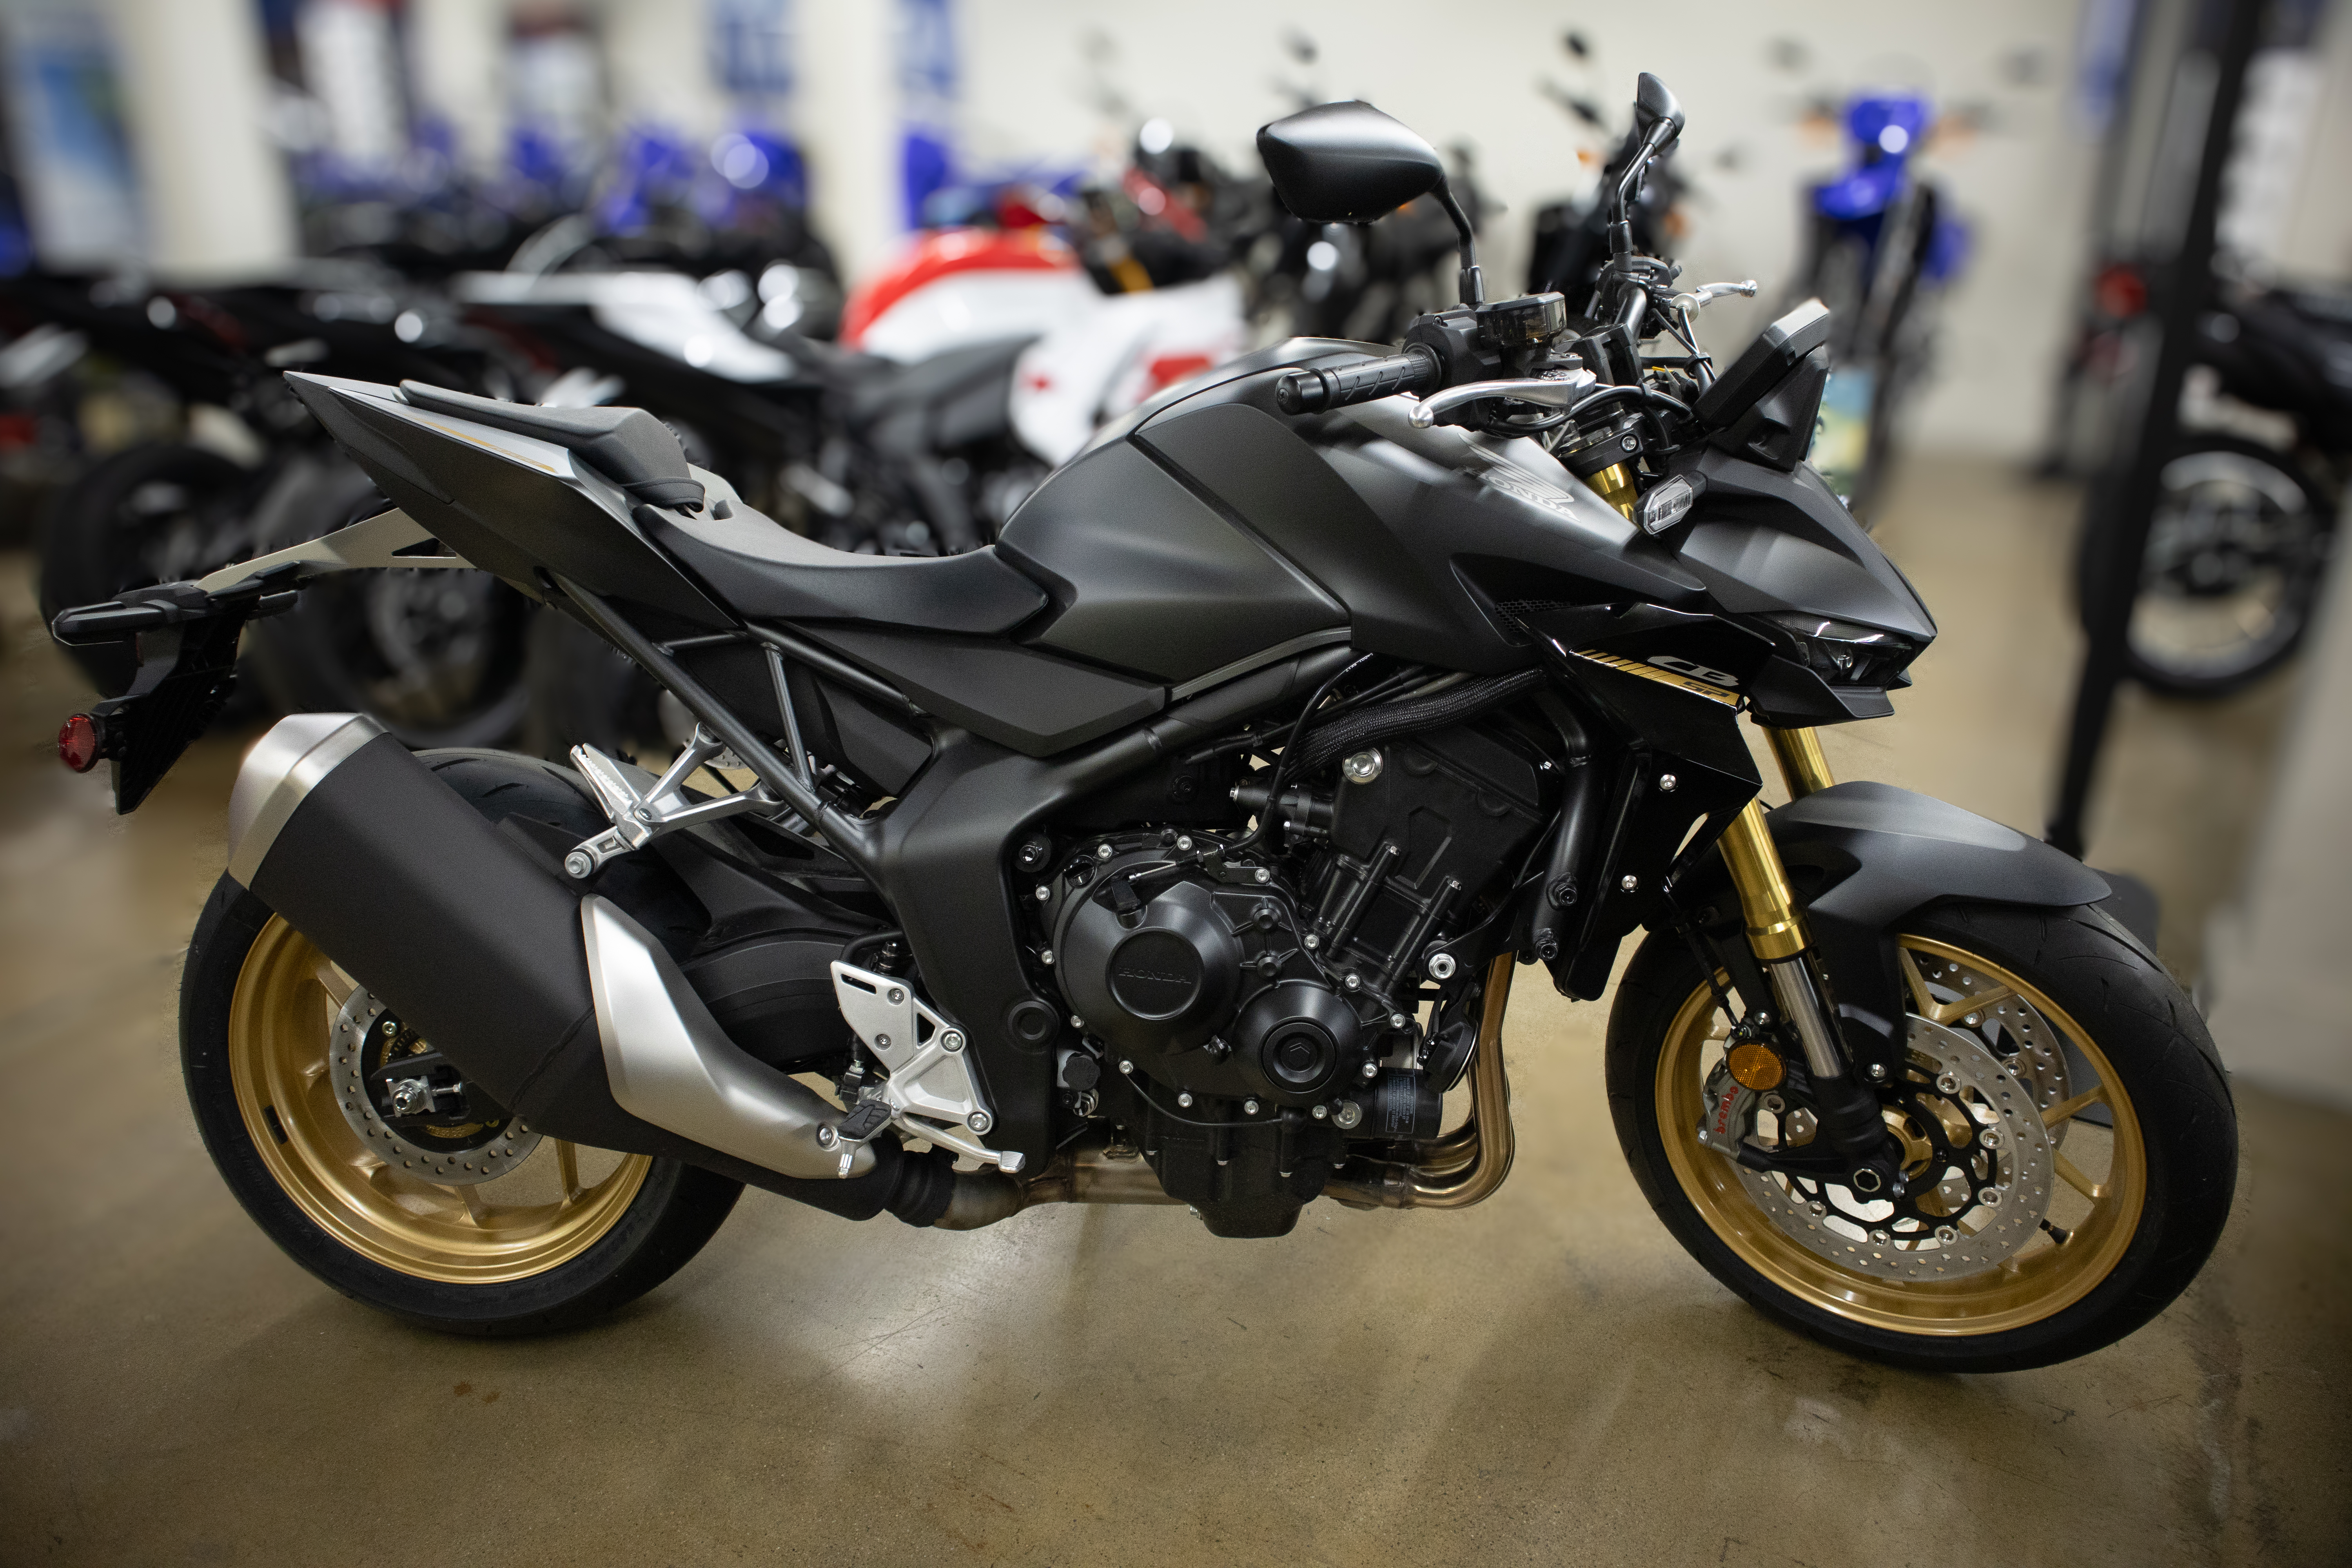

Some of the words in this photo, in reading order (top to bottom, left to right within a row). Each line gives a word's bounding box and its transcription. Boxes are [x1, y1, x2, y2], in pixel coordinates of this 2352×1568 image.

[1463, 465, 1581, 523] HONDA
[1647, 655, 1739, 687] CB
[1679, 681, 1730, 697] SP
[1118, 967, 1192, 985] HONDA
[1713, 1086, 1739, 1134] brembo
